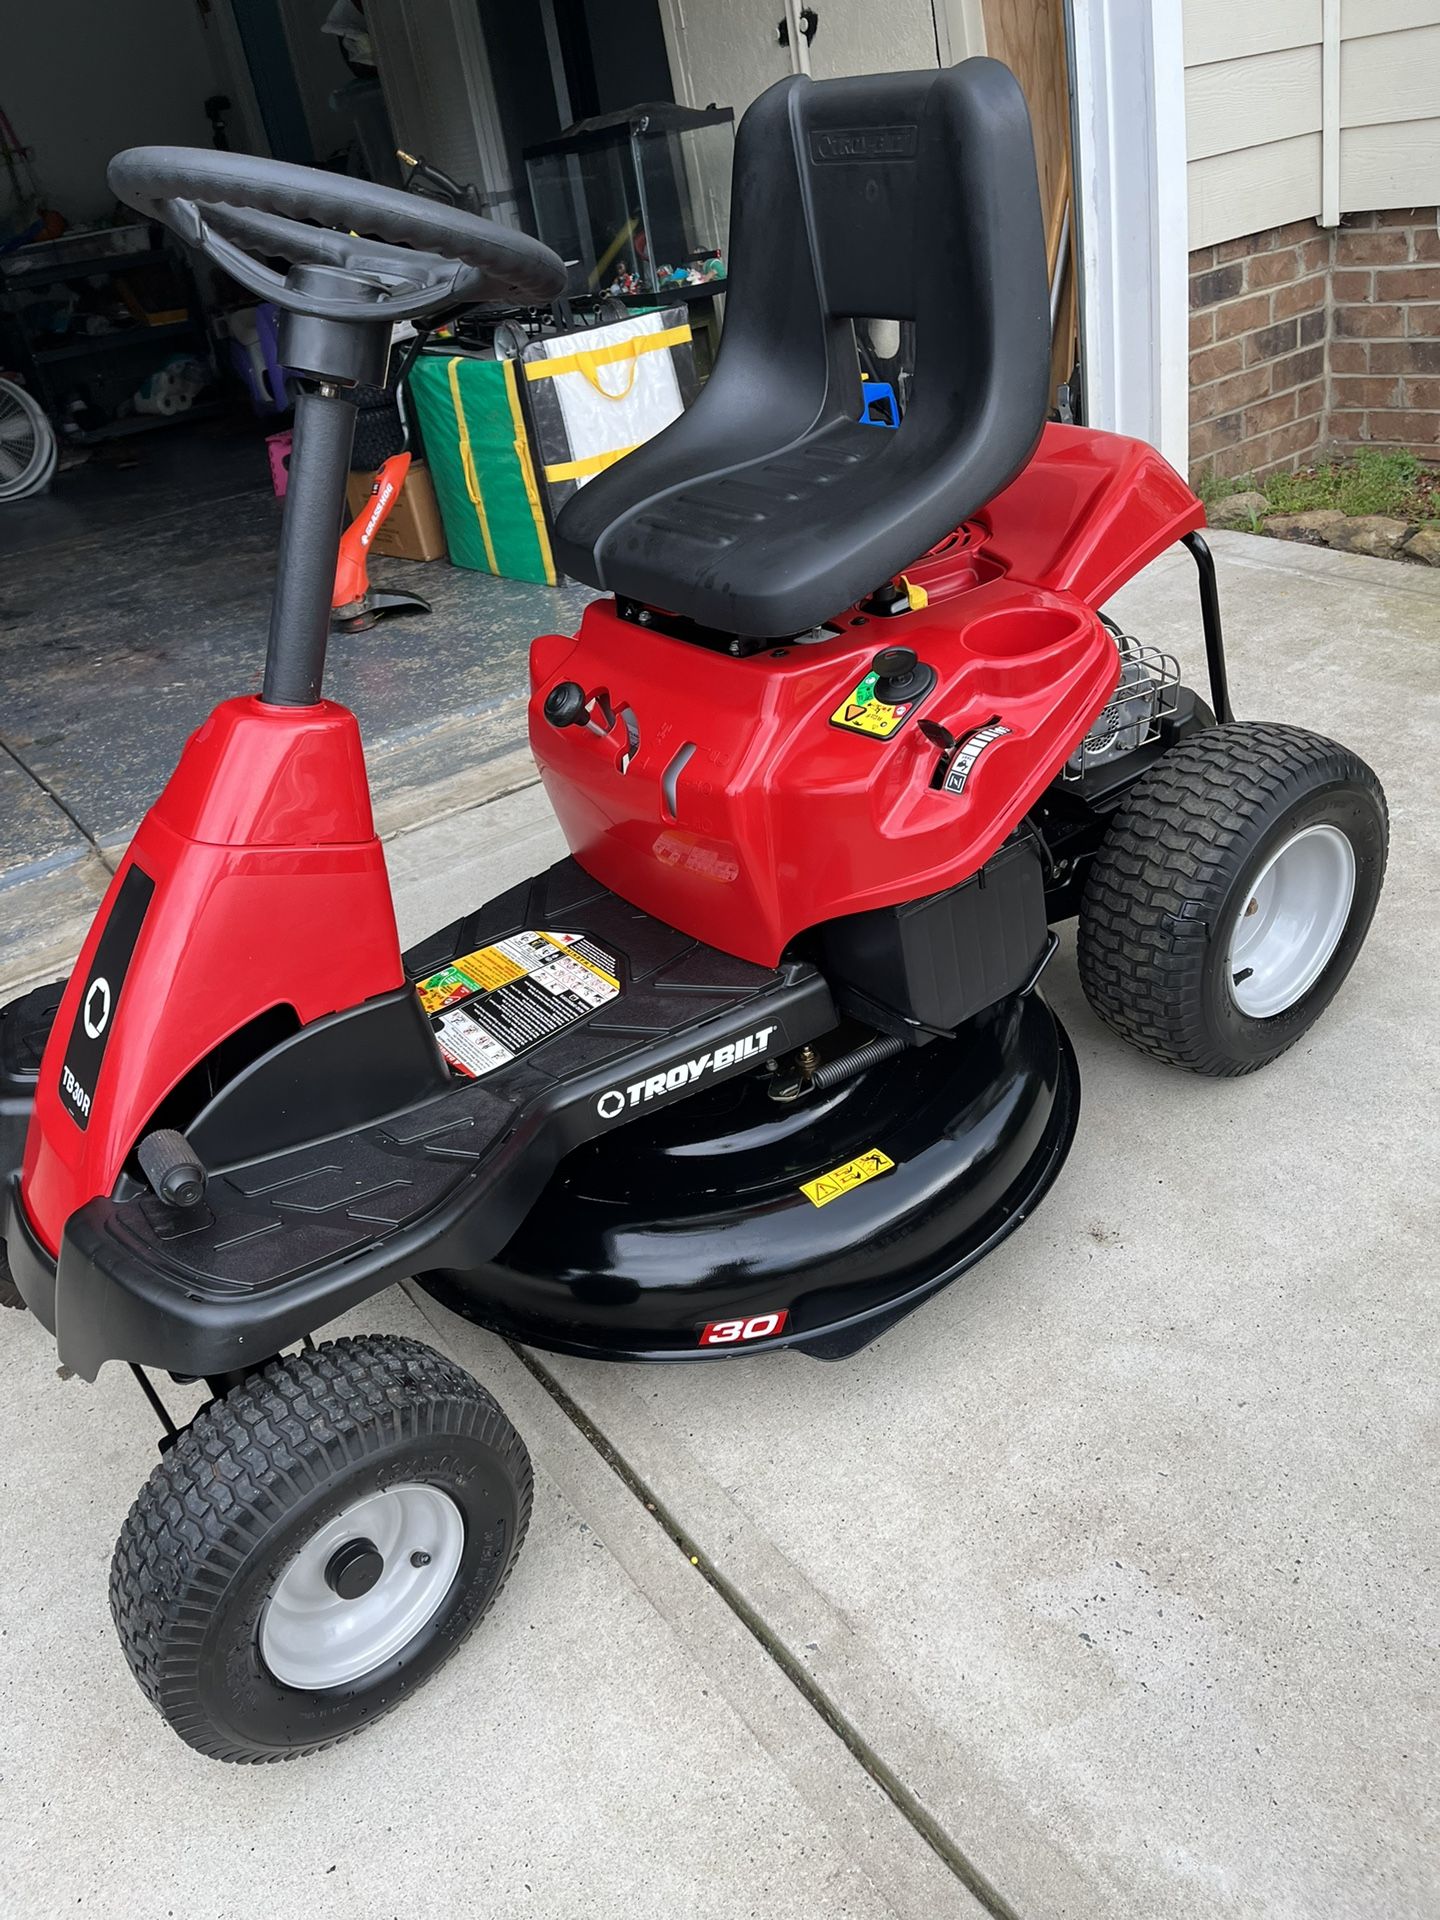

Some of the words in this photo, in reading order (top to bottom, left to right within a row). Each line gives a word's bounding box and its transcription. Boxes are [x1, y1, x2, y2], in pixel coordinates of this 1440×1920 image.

[62, 1065, 91, 1117] TB30R
[627, 1026, 773, 1107] TROY-BILT
[708, 1314, 779, 1344] 30
